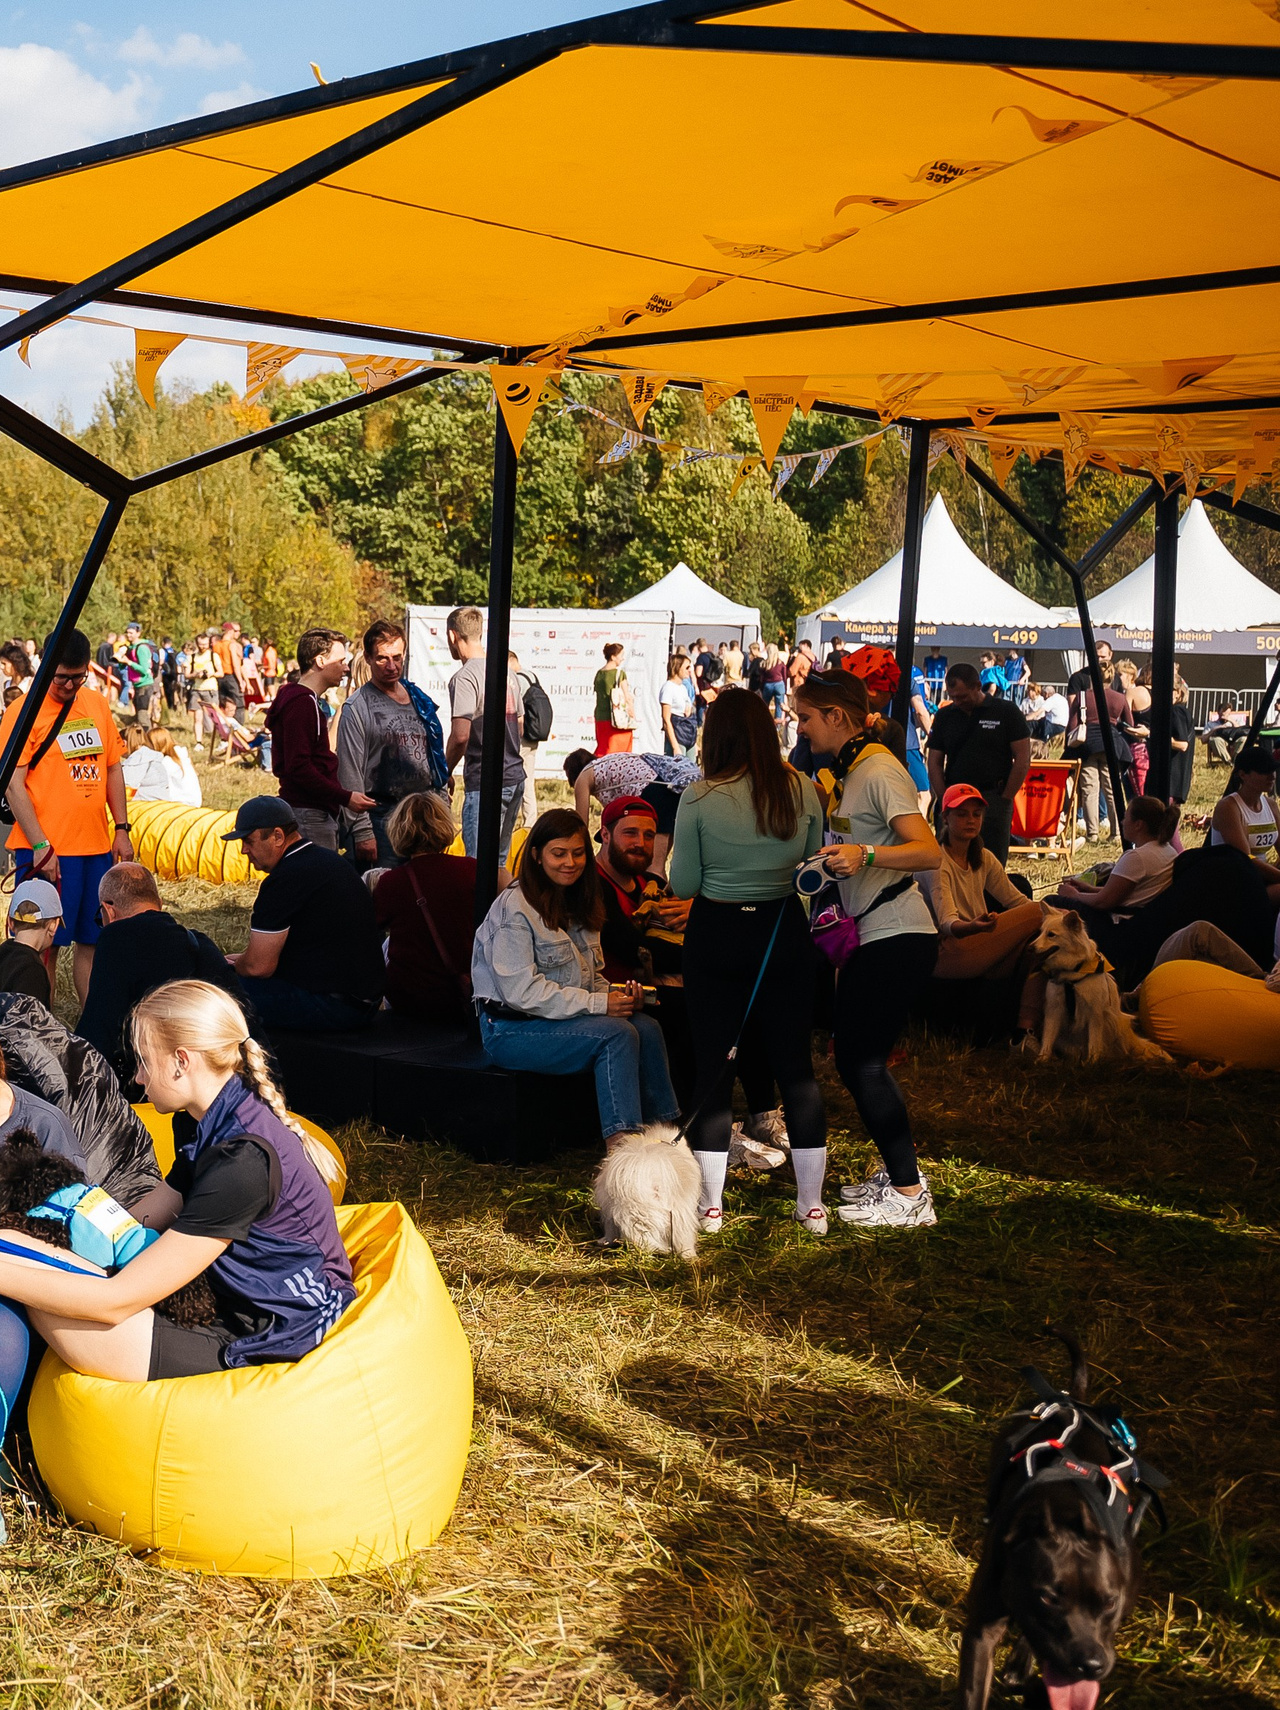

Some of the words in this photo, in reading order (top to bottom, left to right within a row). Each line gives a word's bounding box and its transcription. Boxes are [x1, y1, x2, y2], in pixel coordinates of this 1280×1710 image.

[644, 383, 656, 403] темп
[754, 396, 795, 405] БЫСТРЫЙ
[845, 622, 884, 636] Камера
[861, 633, 891, 644] Baggage
[550, 684, 596, 696] БЫСТР
[68, 731, 94, 748] 106
[72, 765, 99, 779] MSK
[1256, 833, 1274, 846] 232
